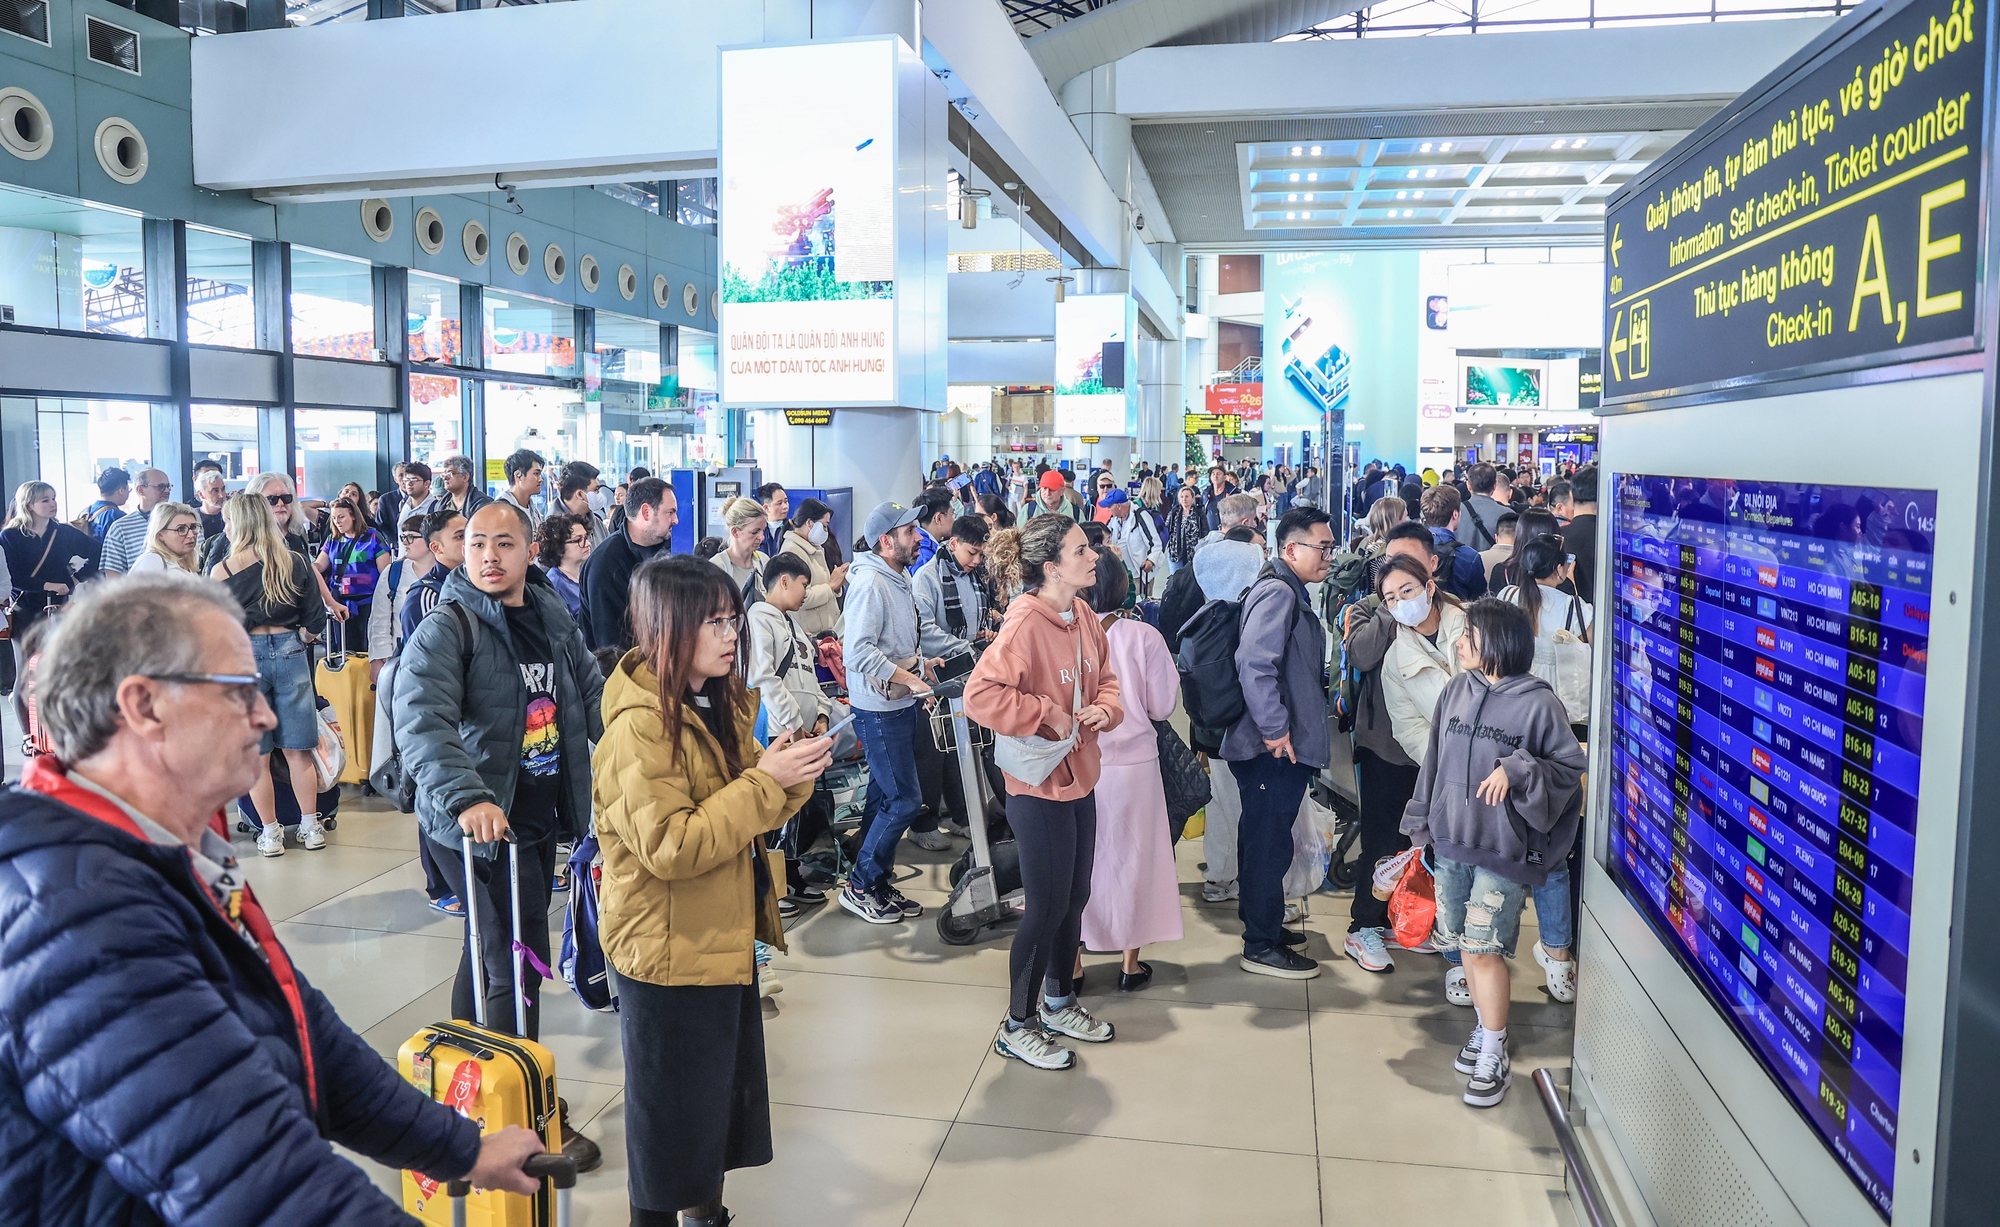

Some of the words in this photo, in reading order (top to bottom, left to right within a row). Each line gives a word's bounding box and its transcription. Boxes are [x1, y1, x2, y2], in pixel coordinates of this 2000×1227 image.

[1646, 191, 1669, 231] Quầy
[1671, 179, 1701, 221] thông
[1703, 166, 1722, 200] tin,
[1725, 155, 1740, 187] tự
[1742, 138, 1768, 177] làm
[1771, 110, 1798, 160] thủ
[1801, 97, 1834, 144] tục,
[1839, 65, 1863, 116] vé
[1868, 39, 1909, 112] giờ
[1912, 0, 1974, 72] chót
[1669, 223, 1723, 267] Information
[1730, 197, 1754, 240] Self
[1756, 170, 1820, 224] check-in,
[1824, 133, 1878, 194] Ticket
[1882, 92, 1971, 167] counter
[1610, 274, 1623, 295] 40m
[1694, 279, 1715, 319] Thủ
[1717, 279, 1739, 316] tục
[1741, 264, 1777, 305] hàng
[1780, 244, 1834, 290] không
[731, 331, 753, 351] QUÂN
[756, 330, 770, 353] ĐỘI
[772, 333, 783, 350] TA
[785, 330, 796, 349] LÀ
[798, 329, 821, 349] QUÂN
[824, 329, 837, 352] ĐỘI
[841, 332, 858, 348] ANH
[861, 328, 885, 348] HÙNG
[1766, 301, 1832, 348] Check-in
[829, 359, 850, 373] ANH
[1240, 394, 1262, 406] 2026
[1743, 510, 1765, 524] Domestic
[1766, 512, 1794, 527] Departures
[1681, 551, 1695, 564] B19-23
[1681, 577, 1695, 590] A05-18
[1705, 585, 1721, 598] Departed
[1781, 572, 1796, 589] VJ153
[1808, 582, 1816, 594] HO
[1817, 584, 1826, 597] CHI
[1826, 585, 1842, 600] MINH
[1851, 590, 1880, 610] A05-18
[1885, 599, 1890, 612] 7
[1680, 602, 1694, 616] A05-18
[1780, 607, 1798, 623] VN7213
[1806, 615, 1815, 627] HO
[1815, 617, 1825, 631] CHI
[1825, 620, 1841, 636] MINH
[1850, 626, 1878, 648] B16-18
[1883, 637, 1888, 651] 2
[1680, 628, 1694, 642] B19-23
[1679, 652, 1693, 668] B19-23
[1805, 648, 1814, 660] HO
[1814, 651, 1824, 665] CHI
[1824, 654, 1839, 671] MINH
[1848, 662, 1876, 685] A05-18
[1882, 676, 1886, 689] 1
[1679, 678, 1692, 694] B19-23
[1804, 681, 1812, 694] HO
[1813, 684, 1822, 698] CHI
[1823, 688, 1838, 706] MINH
[1846, 697, 1874, 723] A05-18
[1879, 714, 1888, 729] 12
[1678, 703, 1691, 720] B16-18
[1700, 746, 1710, 761] Ferry
[1802, 714, 1811, 729] HO
[1811, 718, 1821, 732] CHI
[1821, 722, 1836, 741] MINH
[1844, 733, 1872, 760] B16-18
[1876, 751, 1882, 764] 4
[1676, 753, 1690, 772] B16-18
[1800, 747, 1809, 761] DA
[1809, 752, 1825, 770] NANG
[1842, 768, 1869, 797] B19-23
[1874, 788, 1880, 801] 7
[1675, 778, 1689, 798] B19-23
[1799, 779, 1810, 796] PHU
[1811, 786, 1827, 807] QUOC
[1840, 804, 1868, 834] A27-32
[1674, 803, 1688, 823] A27-32
[1673, 828, 1686, 848] E18-29
[1797, 812, 1806, 827] HO
[1806, 817, 1816, 834] CHI
[1816, 824, 1830, 845] MINH
[1838, 839, 1864, 870] E04-08
[1870, 864, 1878, 879] 17
[1795, 845, 1815, 868] PLEIKU
[1836, 875, 1862, 906] E18-29
[1867, 901, 1876, 916] 15
[1793, 877, 1801, 891] DA
[1801, 883, 1817, 906] NANG
[1833, 910, 1860, 943] A20-25
[1864, 938, 1873, 953] 10
[1791, 909, 1800, 925] DA
[1799, 916, 1810, 935] LAT
[1830, 944, 1857, 977] E18-29
[1862, 974, 1870, 991] 14
[1788, 942, 1797, 957] DA
[1796, 949, 1812, 973] NANG
[1828, 979, 1855, 1015] A05-18
[1859, 1011, 1864, 1023] 1
[1786, 973, 1794, 990] HO
[1794, 980, 1804, 998] CHI
[1803, 990, 1818, 1015] MINH
[1825, 1014, 1851, 1050] A20-25
[1781, 1037, 1793, 1060] CAM
[1793, 1050, 1809, 1076] RANH
[1820, 1081, 1846, 1121] B19-23
[1784, 1005, 1795, 1025] PHU
[1795, 1016, 1811, 1043] QUOC
[1870, 1101, 1895, 1136] Charter
[1846, 1152, 1871, 1191] January
